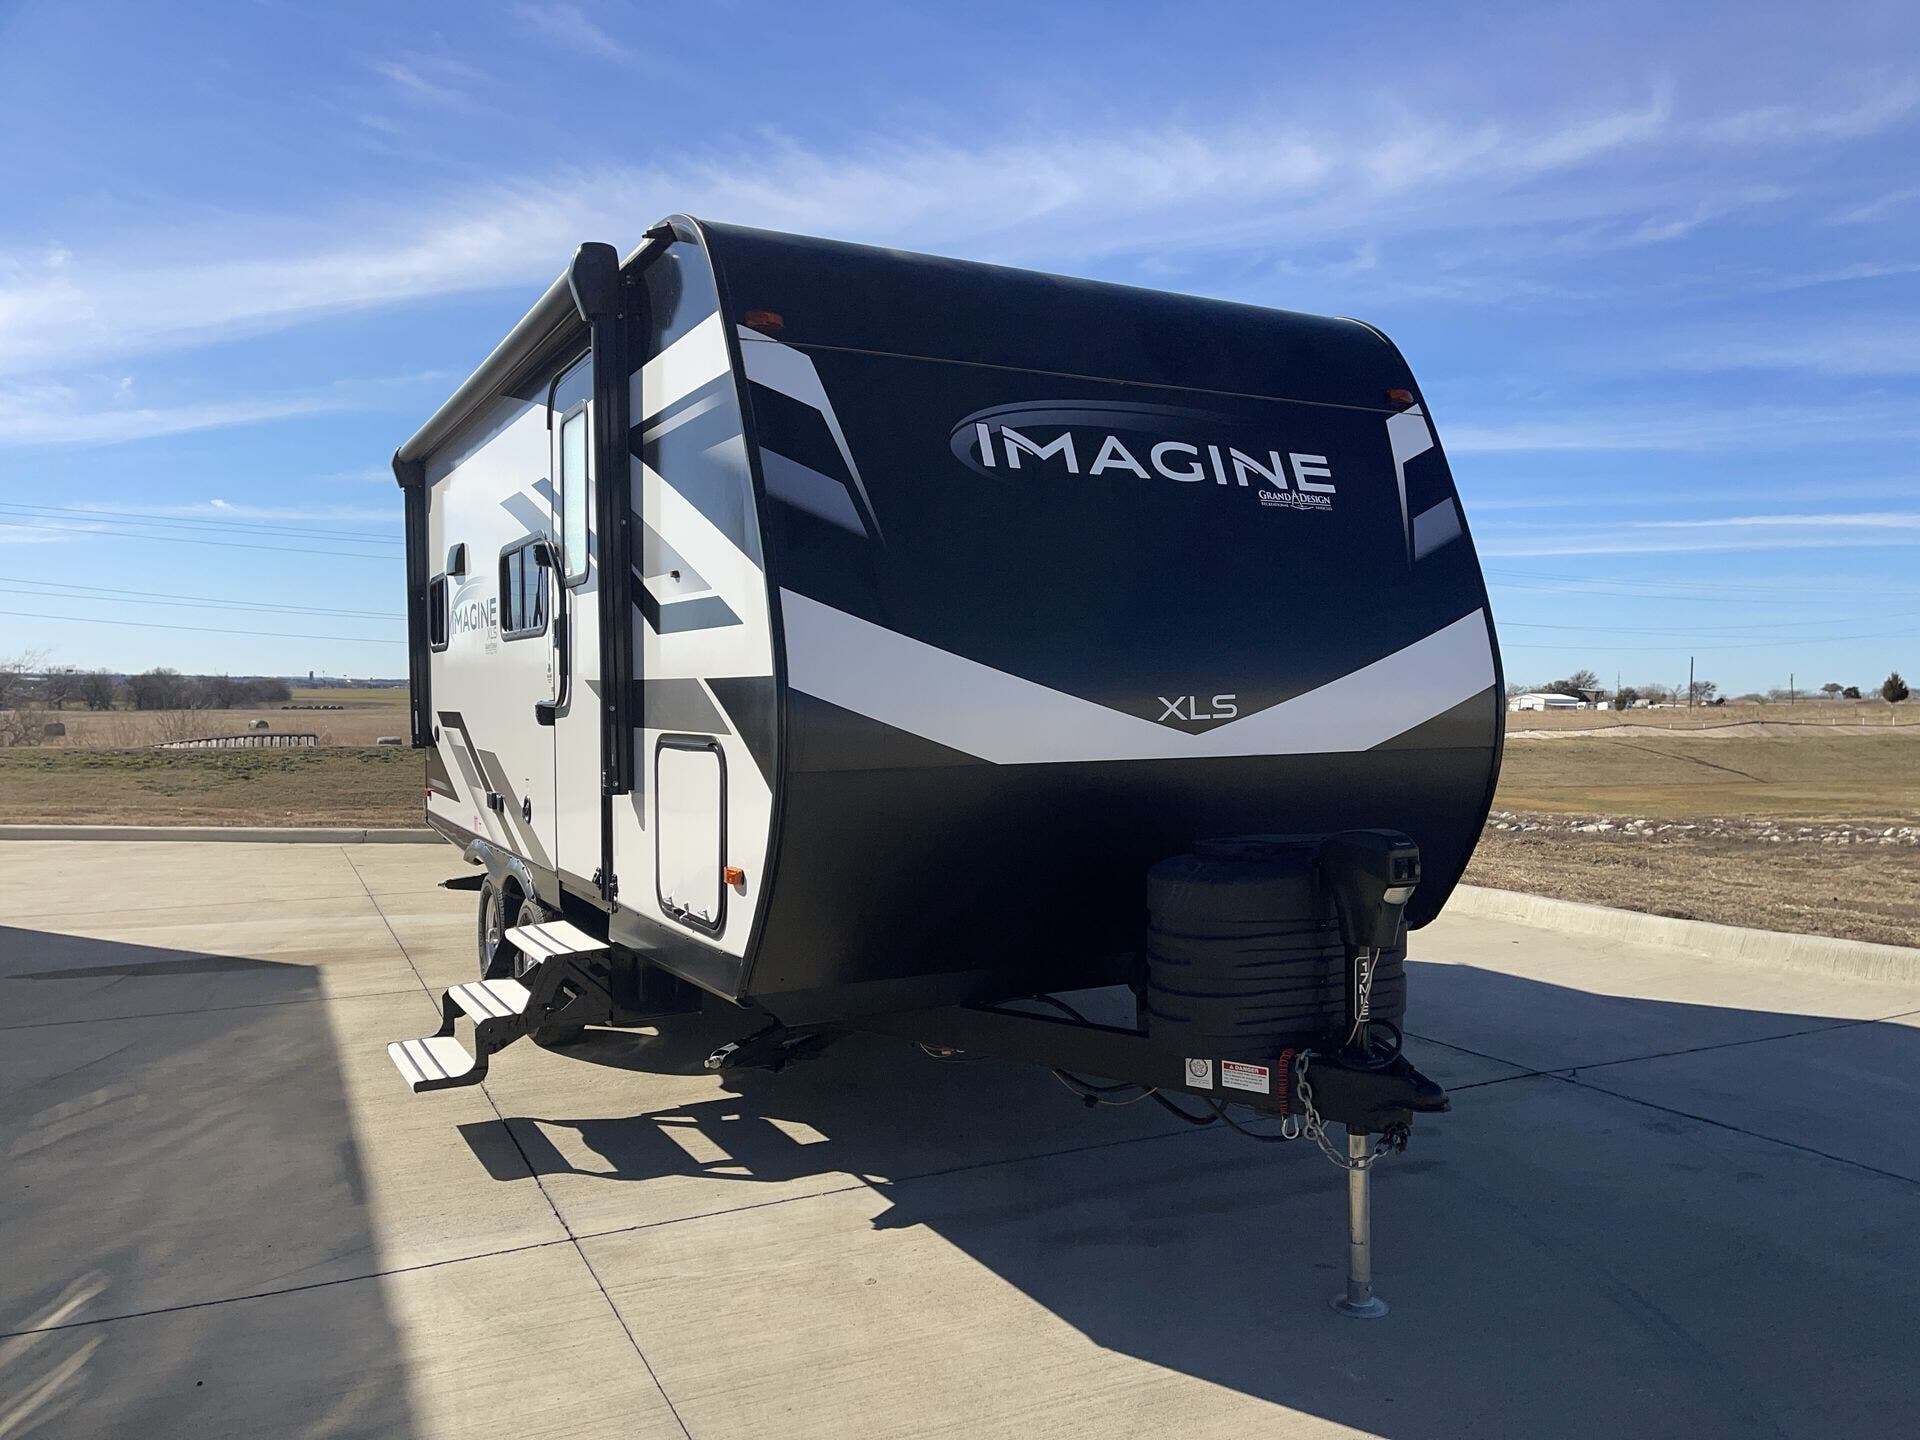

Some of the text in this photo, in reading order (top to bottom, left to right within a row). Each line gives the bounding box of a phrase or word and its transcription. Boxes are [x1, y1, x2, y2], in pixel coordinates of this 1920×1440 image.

[975, 422, 1336, 494] IMAGINE
[1258, 489, 1331, 504] GRAND DESIGN
[452, 598, 496, 634] IMAGINE
[1157, 693, 1238, 722] XLS
[1234, 1065, 1259, 1074] DANGER
